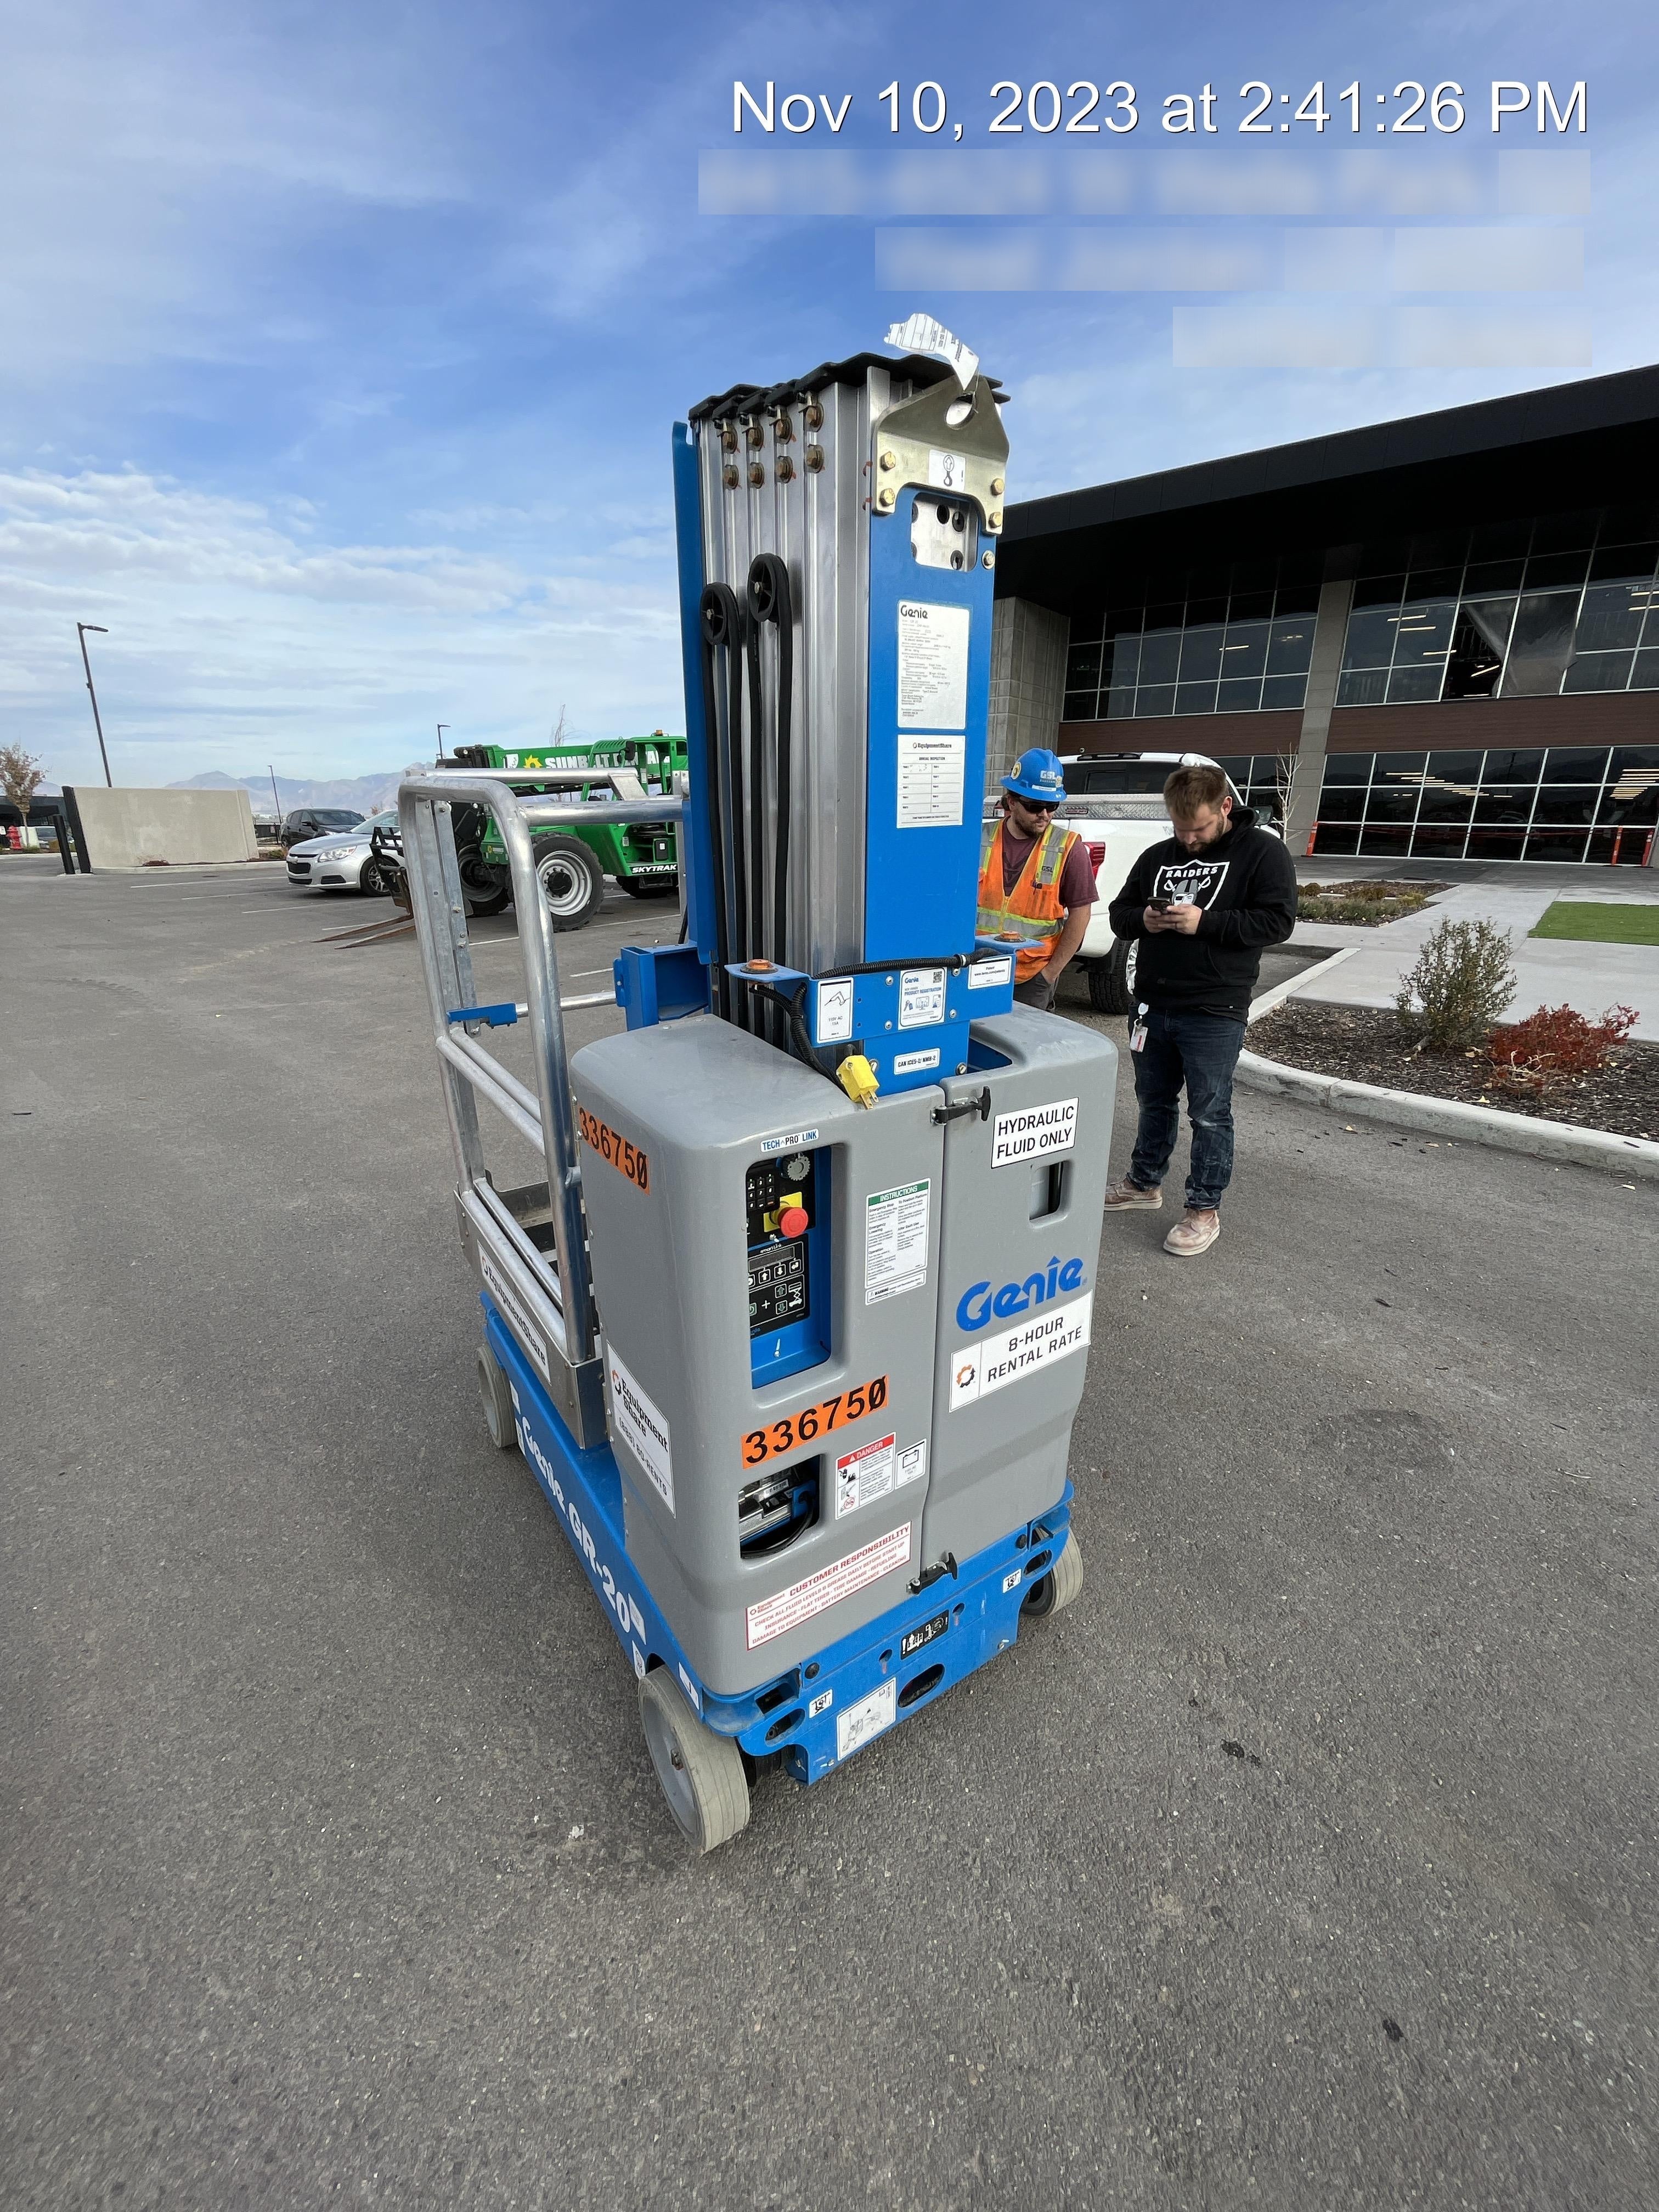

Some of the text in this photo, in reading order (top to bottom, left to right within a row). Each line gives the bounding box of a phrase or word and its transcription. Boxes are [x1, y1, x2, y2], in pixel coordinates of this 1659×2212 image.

[900, 605, 928, 619] Genie
[545, 753, 611, 769] SUNBLT
[1040, 770, 1056, 780] GSL
[632, 864, 677, 873] SKYTRAK
[1165, 866, 1218, 878] RAIDERS
[998, 1105, 1074, 1136] HYDRAULIC
[579, 1107, 647, 1189] 336750
[763, 1139, 780, 1150] TECH
[802, 1131, 817, 1142] LINK
[997, 1127, 1073, 1159] FLUID ONLY
[880, 1185, 918, 1202] INSTRUCTIONS
[956, 1255, 1084, 1331] Genie
[488, 1266, 546, 1366] EquipmentShare
[1009, 1317, 1063, 1352] 8-HOUR
[988, 1325, 1082, 1383] RENTAL RATE
[622, 1378, 668, 1452] Equipment
[623, 1395, 646, 1437] Share
[746, 1375, 886, 1464] 336750
[857, 1441, 883, 1459] DANGER
[522, 1416, 630, 1633] Genie GR-20
[790, 1526, 909, 1596] CUSTOMER RESPONSIBILITY
[753, 1629, 777, 1644] DAMAGE
[786, 1606, 818, 1627] EQUIPMENT
[821, 1590, 843, 1607] BATTERY
[844, 1571, 880, 1594] MAINTENANCE
[883, 1555, 906, 1571] CLEANING
[755, 1615, 774, 1627] CHECK
[786, 1599, 802, 1611] FLUID
[803, 1589, 821, 1601] LEVELS
[827, 1575, 847, 1588] GREASE
[848, 1565, 862, 1576] DAILY
[863, 1556, 882, 1567] BEFORE
[882, 1546, 897, 1556] START
[758, 1593, 785, 1609] Equipment
[765, 1610, 797, 1630] INSURANCE
[801, 1602, 812, 1611] FLAT
[814, 1592, 830, 1603] TIRES
[834, 1582, 845, 1592] TIRE
[847, 1570, 867, 1585] DAMAGE
[871, 1553, 897, 1571] REFUELING
